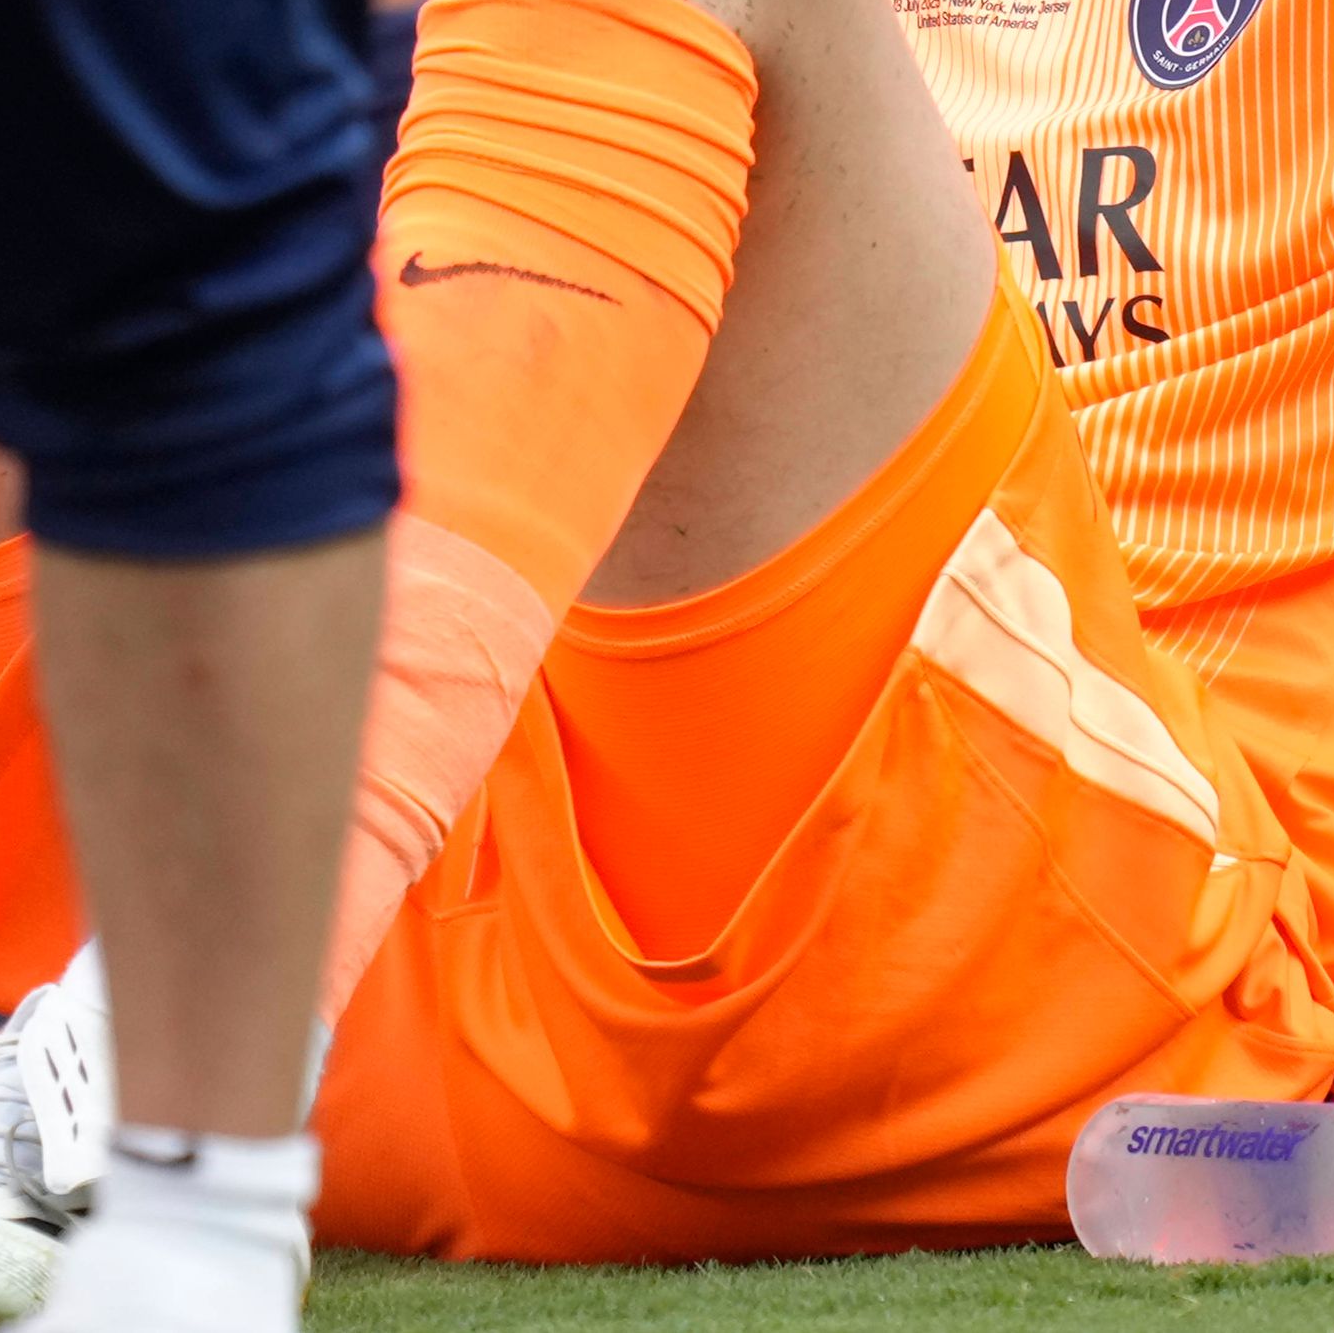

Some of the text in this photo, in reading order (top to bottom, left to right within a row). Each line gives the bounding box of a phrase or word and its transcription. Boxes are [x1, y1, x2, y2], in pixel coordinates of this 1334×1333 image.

[917, 11, 1038, 30] United States of America
[1009, 2, 1037, 15] New
[1038, 1, 1071, 15] Jersey
[963, 146, 1165, 281] AR
[1127, 1123, 1305, 1162] smartwater
